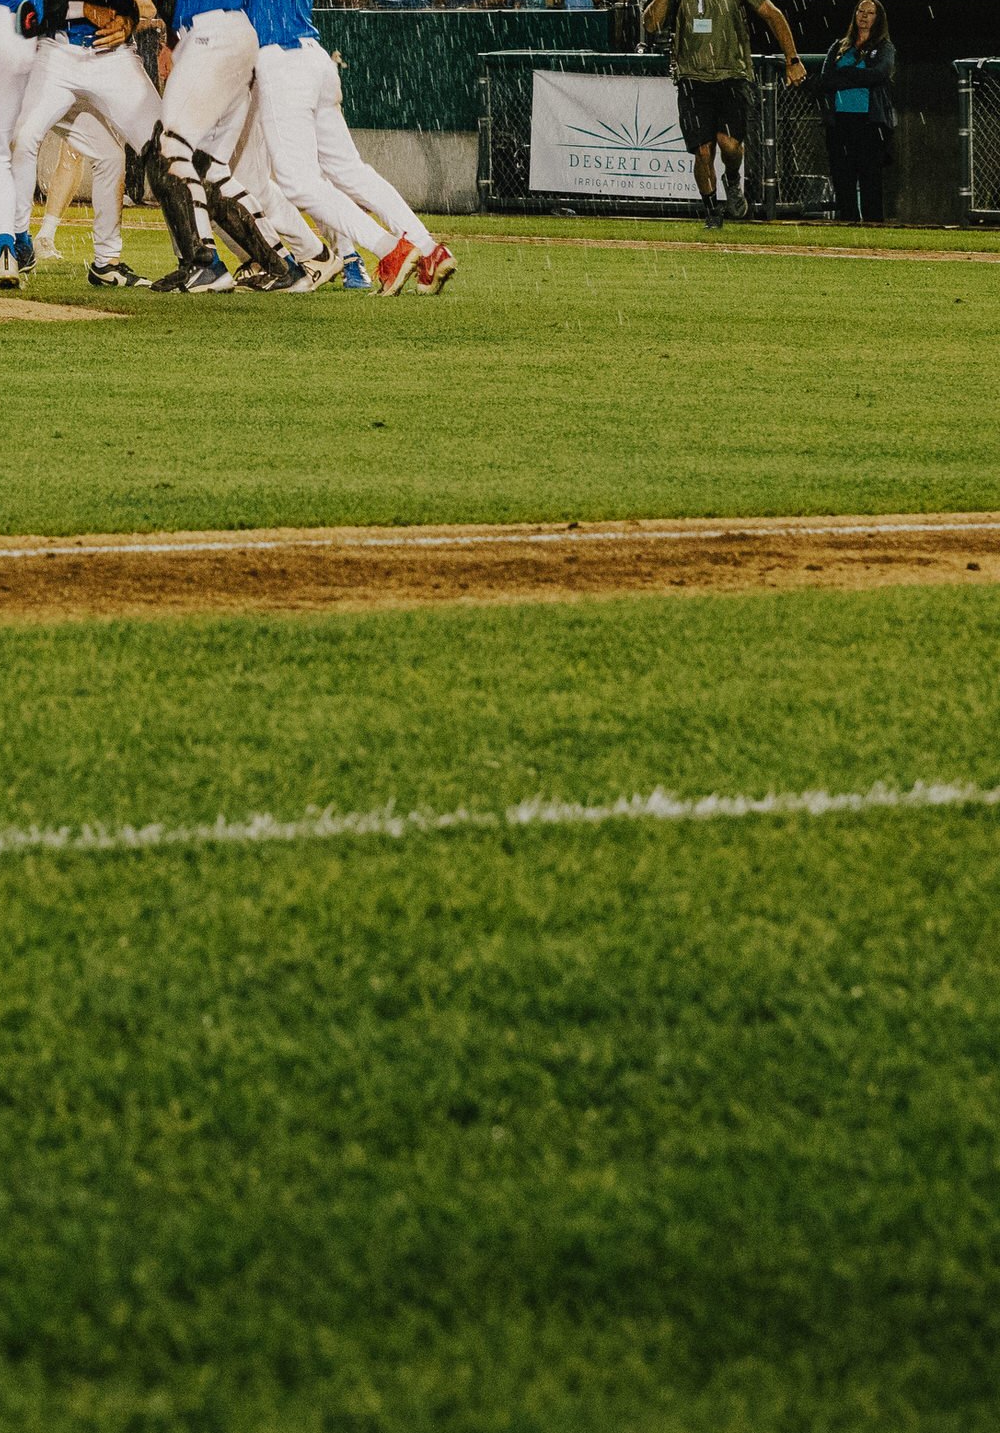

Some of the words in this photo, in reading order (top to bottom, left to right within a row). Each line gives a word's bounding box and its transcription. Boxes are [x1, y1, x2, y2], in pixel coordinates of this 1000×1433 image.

[569, 154, 641, 171] DESERT
[649, 158, 694, 174] OASI
[574, 177, 635, 189] IRRIGATION
[640, 181, 698, 192] SOLUTIONS
